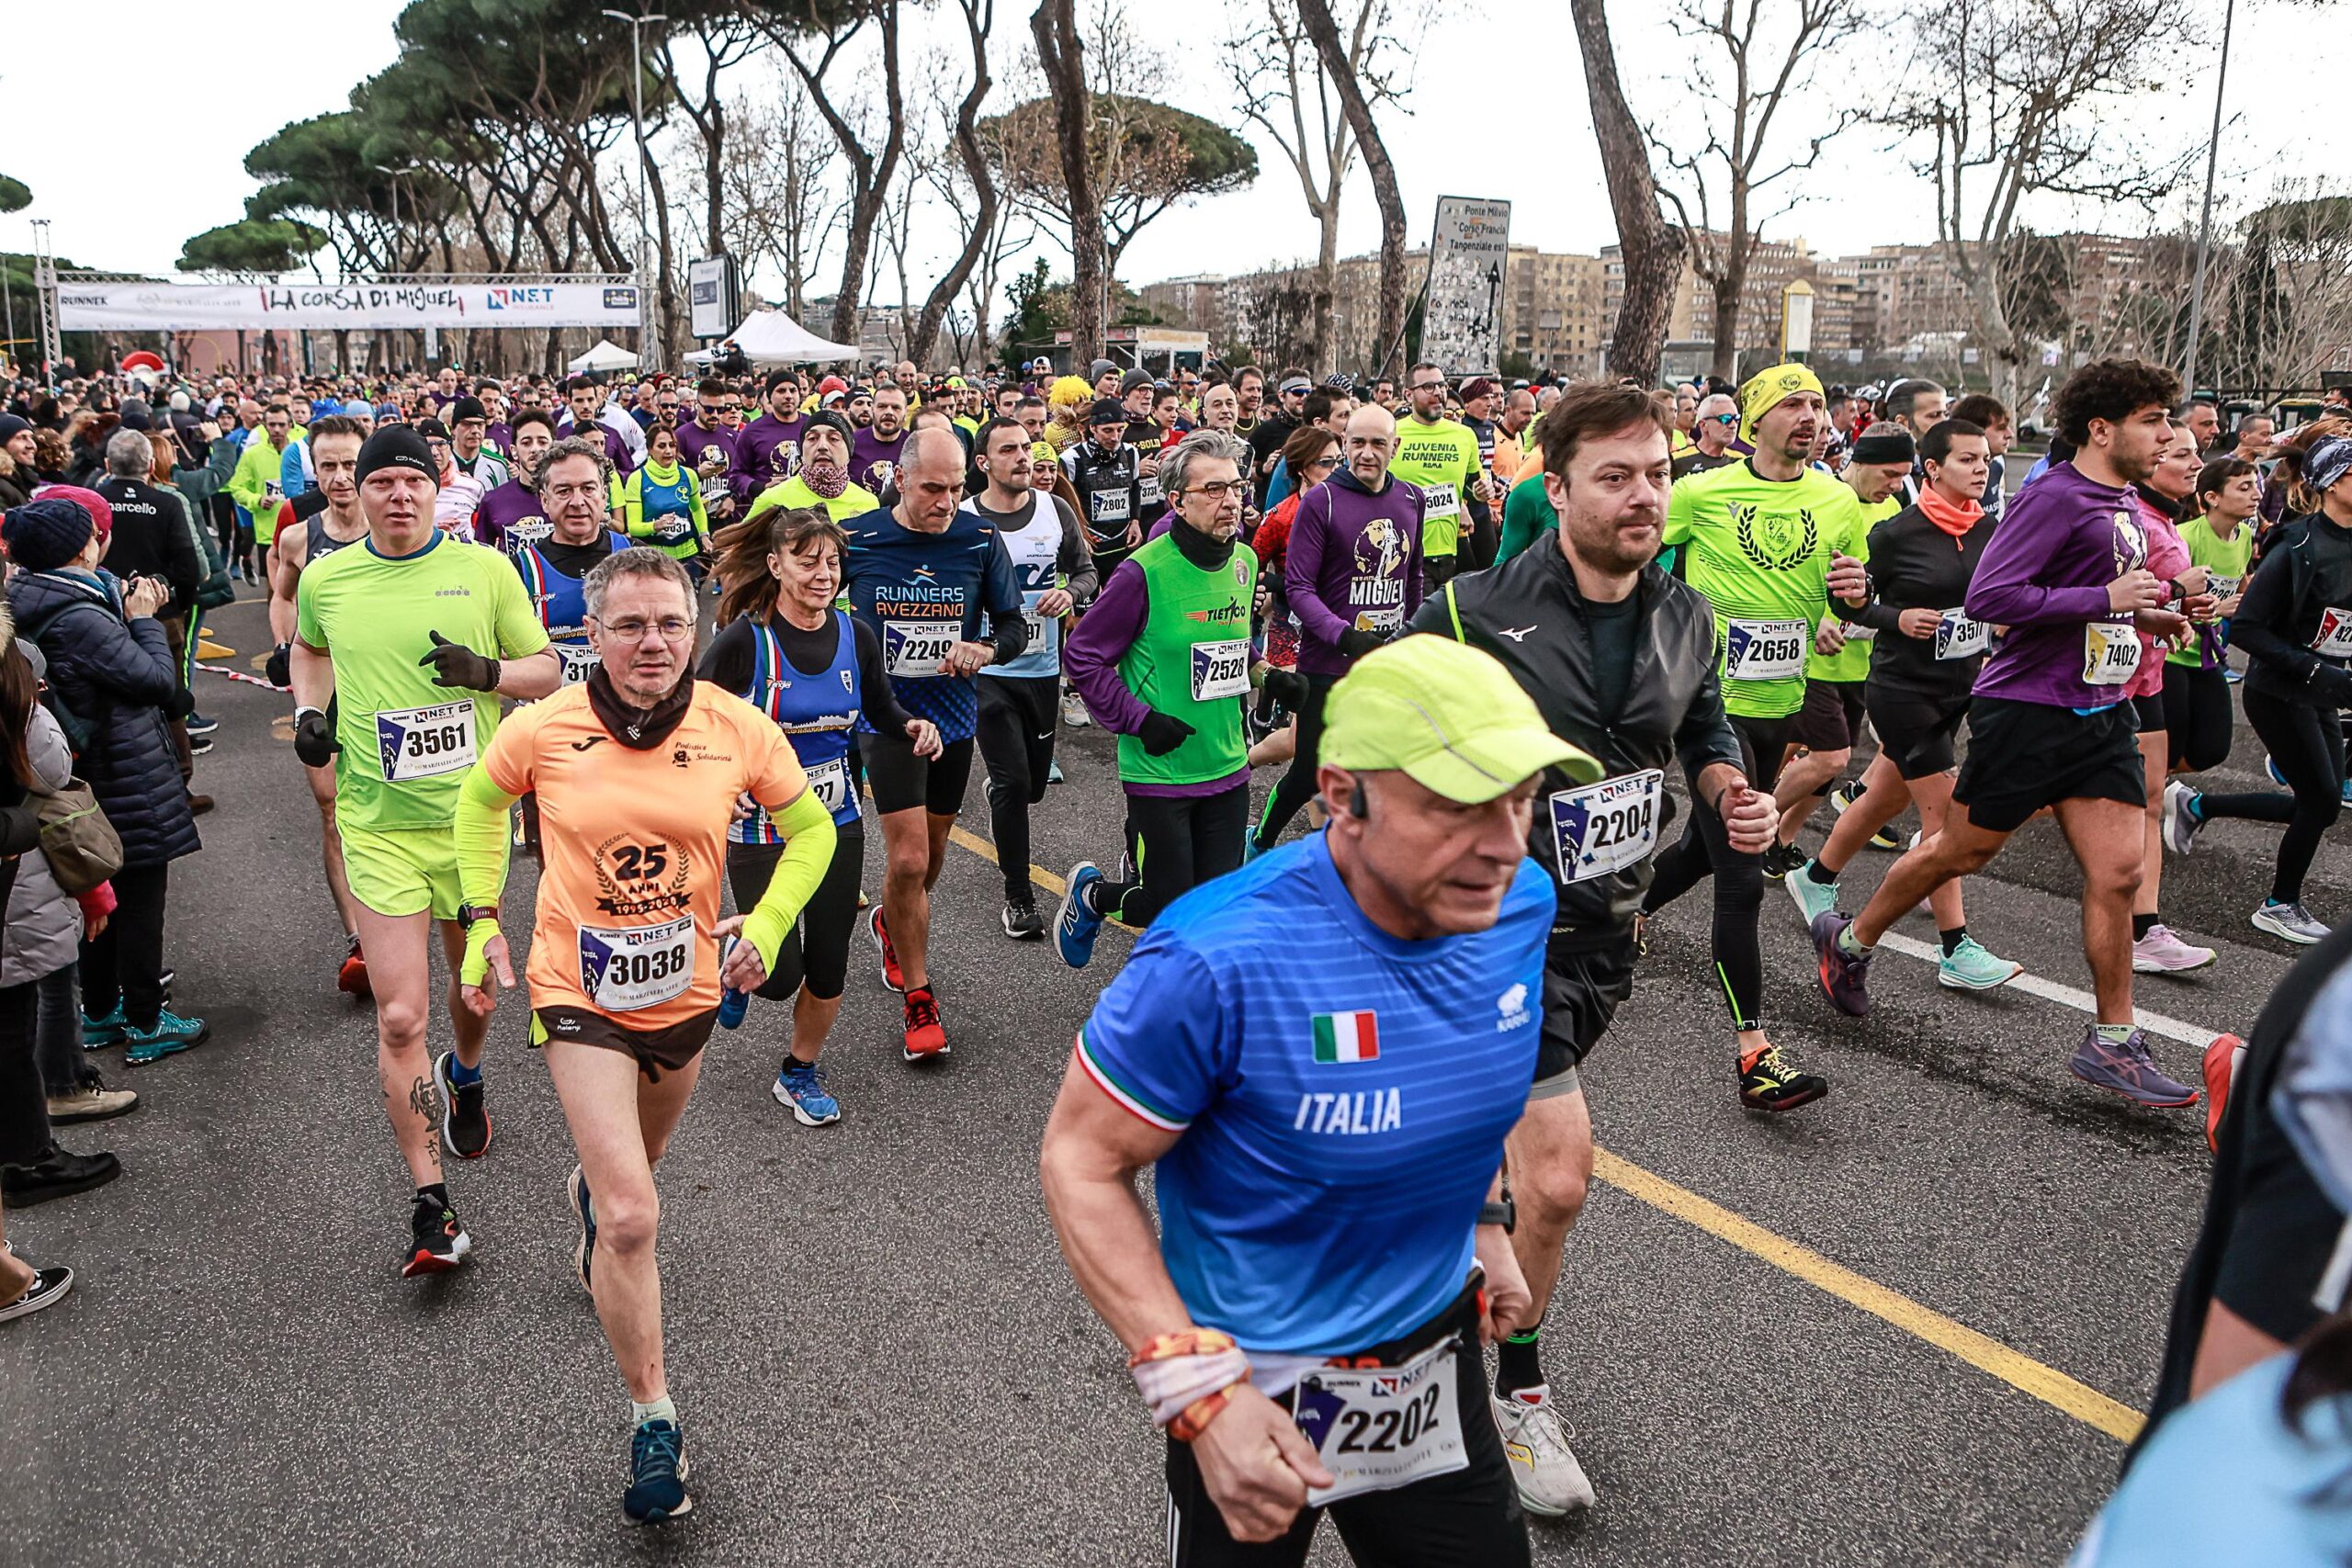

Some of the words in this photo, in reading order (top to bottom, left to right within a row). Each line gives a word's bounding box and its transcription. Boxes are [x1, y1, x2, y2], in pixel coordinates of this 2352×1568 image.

[1464, 205, 1486, 216] Ponte
[1487, 206, 1508, 218] Milvio
[1482, 222, 1506, 235] Francia
[1450, 240, 1492, 253] Tangenziale
[1494, 242, 1504, 252] est
[270, 290, 296, 310] LA
[301, 289, 365, 310] CORSA
[512, 288, 553, 302] NET
[1404, 443, 1457, 452] JUVENIA
[1402, 453, 1459, 462] RUNNERS
[1102, 498, 1126, 511] 2802
[1426, 493, 1453, 508] 5024
[876, 586, 964, 603] RUNNERS
[876, 603, 964, 616] AVEZZANO
[1749, 638, 1800, 661] 2658
[2107, 645, 2136, 666] 7402
[1210, 657, 1244, 682] 2528
[429, 706, 454, 717] NET
[406, 723, 467, 757] 3561
[675, 741, 707, 750] Podistica
[807, 766, 826, 778] NET
[1615, 779, 1643, 795] NET
[1591, 798, 1652, 849] 2204
[612, 844, 667, 881] 25
[628, 883, 660, 894] ANNI
[616, 897, 677, 914] 1995-2020
[644, 927, 673, 942] NET
[610, 943, 685, 987] 3038
[1294, 1087, 1401, 1135] ITALIA
[1338, 1382, 1441, 1455] 2202
